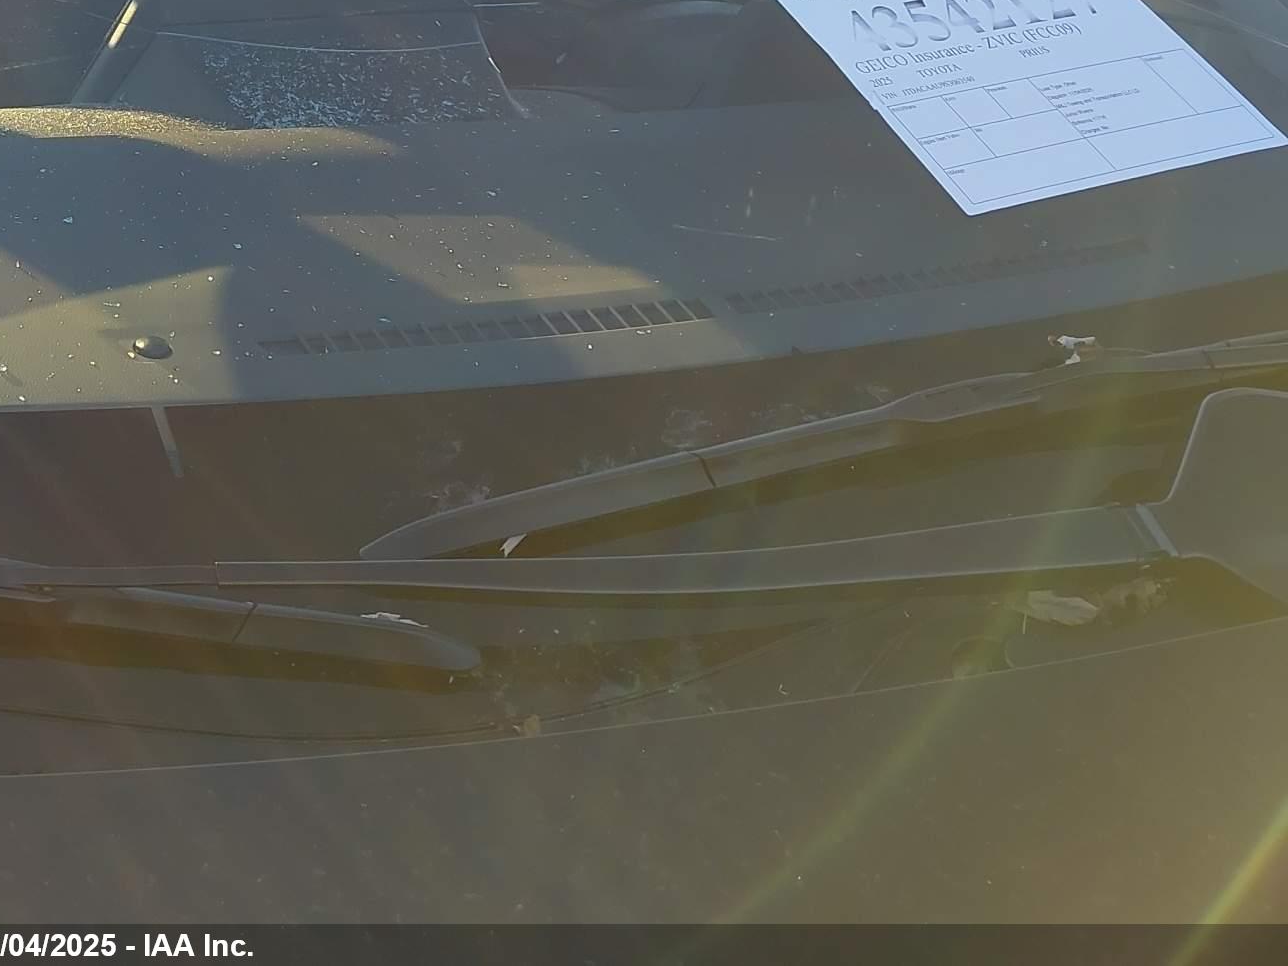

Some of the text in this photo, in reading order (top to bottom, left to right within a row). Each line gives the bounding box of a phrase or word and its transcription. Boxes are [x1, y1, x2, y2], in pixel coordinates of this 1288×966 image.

[855, 53, 909, 74] GEICO
[911, 42, 975, 64] Insurance
[869, 46, 1051, 88] 2025 TOYOTA PRIUS
